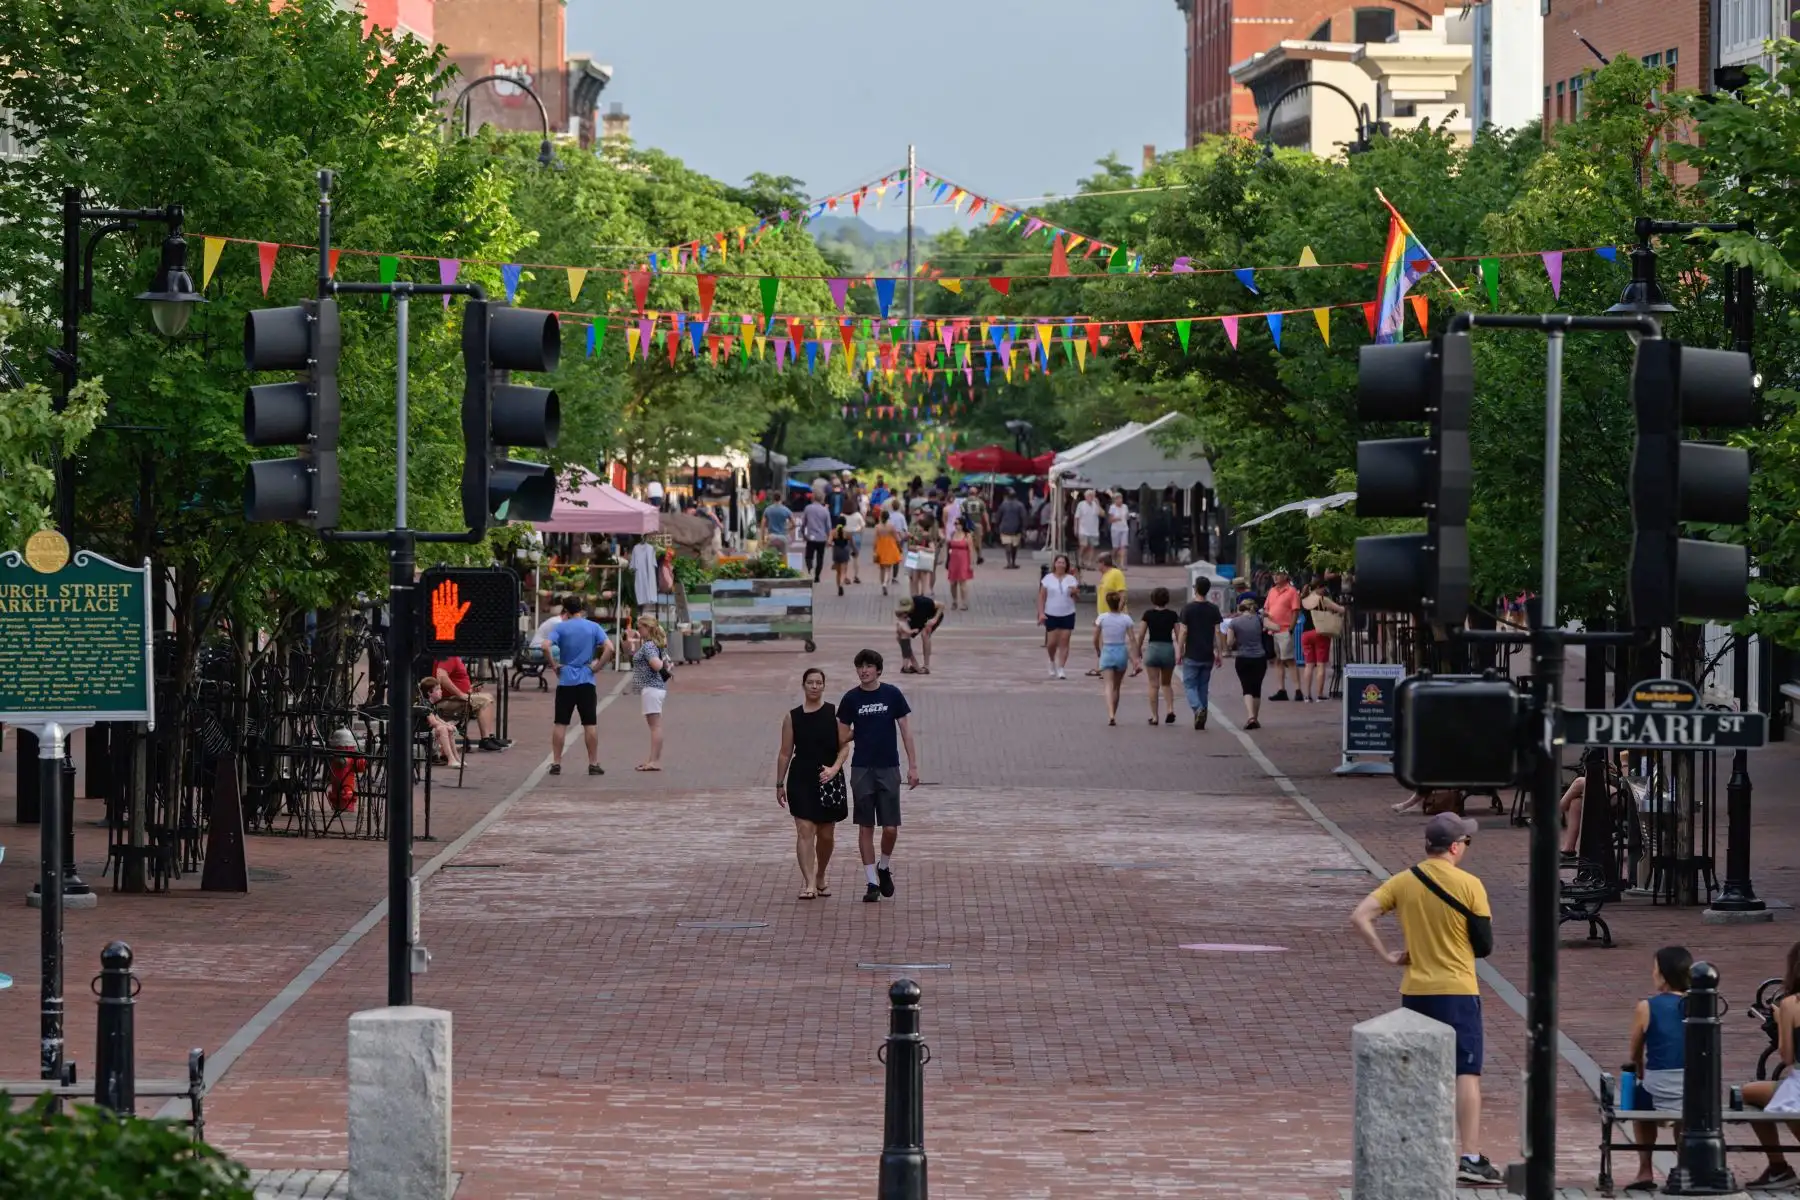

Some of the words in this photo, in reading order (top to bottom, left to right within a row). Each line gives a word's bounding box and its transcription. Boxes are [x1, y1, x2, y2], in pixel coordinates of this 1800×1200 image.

[60, 584, 132, 597] STREET
[1585, 714, 1715, 744] PEARL
[1717, 716, 1745, 732] ST
